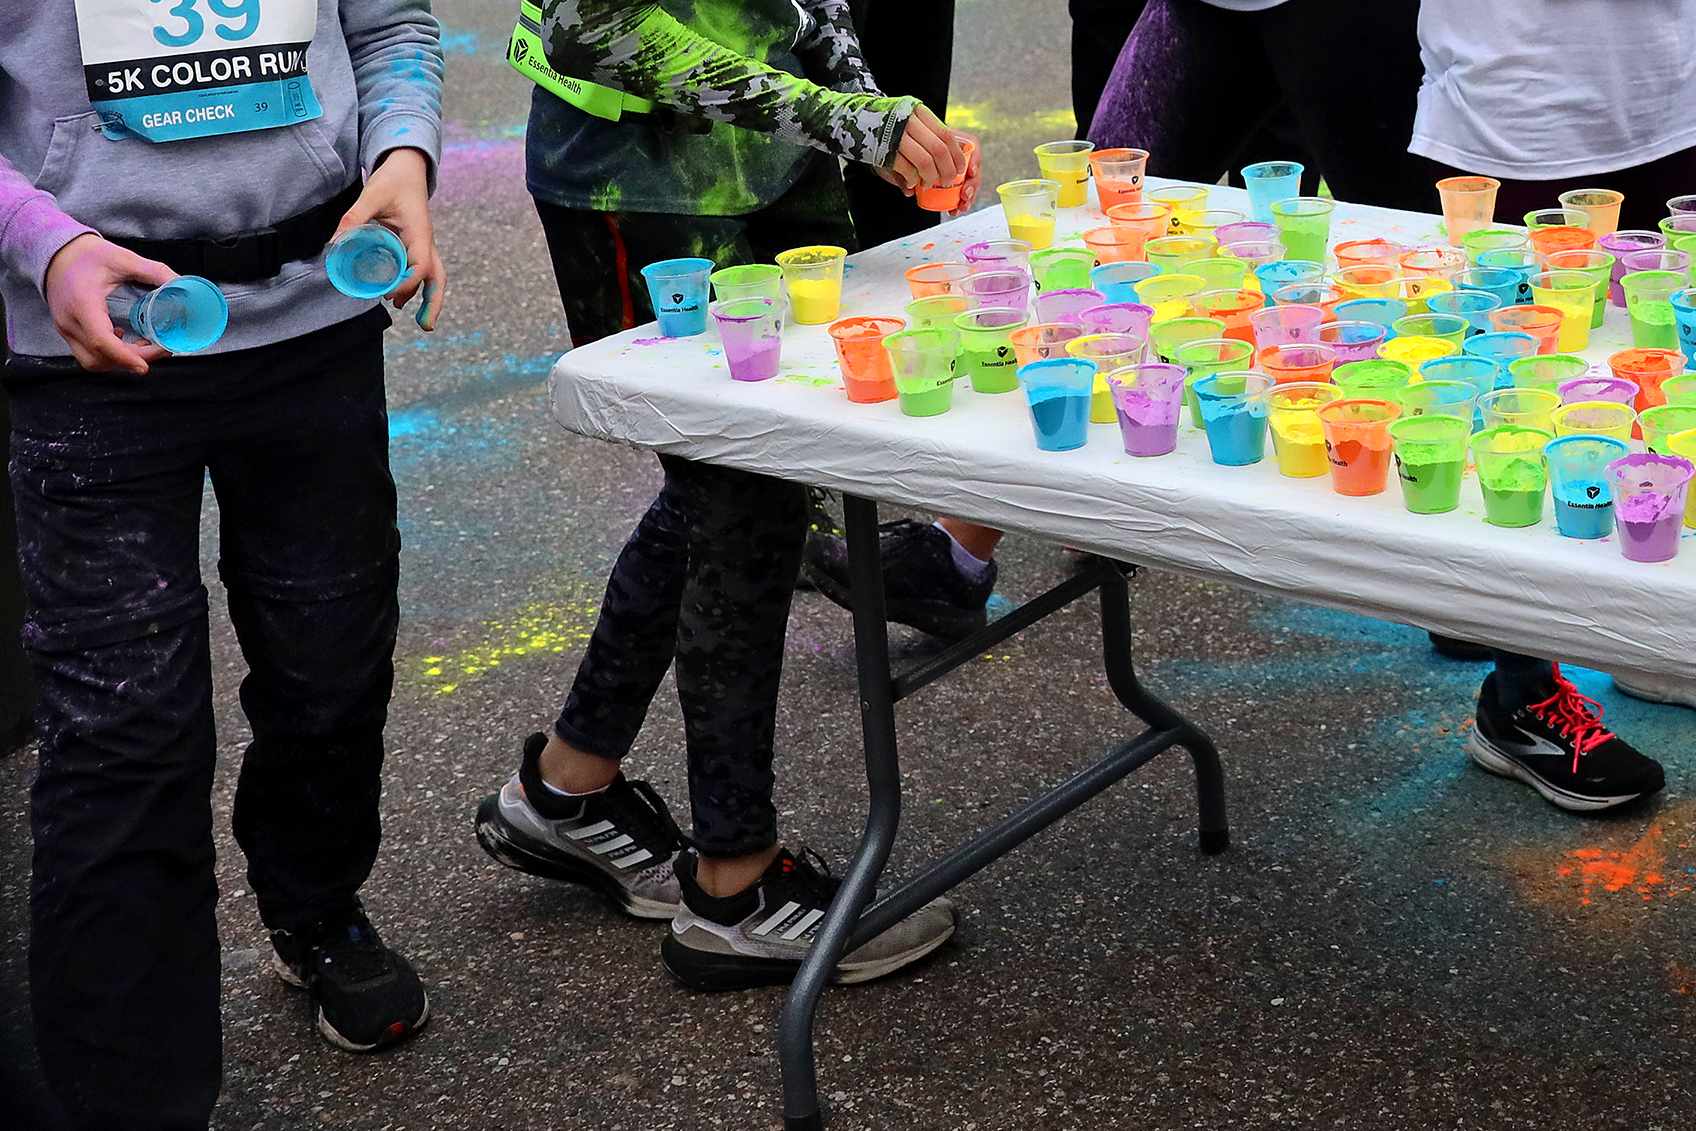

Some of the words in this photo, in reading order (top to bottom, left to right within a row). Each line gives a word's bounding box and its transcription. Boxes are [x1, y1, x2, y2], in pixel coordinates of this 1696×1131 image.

[107, 67, 145, 94] 5K
[151, 56, 252, 89] COLOR
[528, 55, 558, 81] Essentia
[557, 74, 582, 96] Health
[142, 110, 183, 129] GEAR
[184, 104, 236, 123] CHECK
[254, 101, 269, 112] 39
[1567, 500, 1594, 510] Essentia
